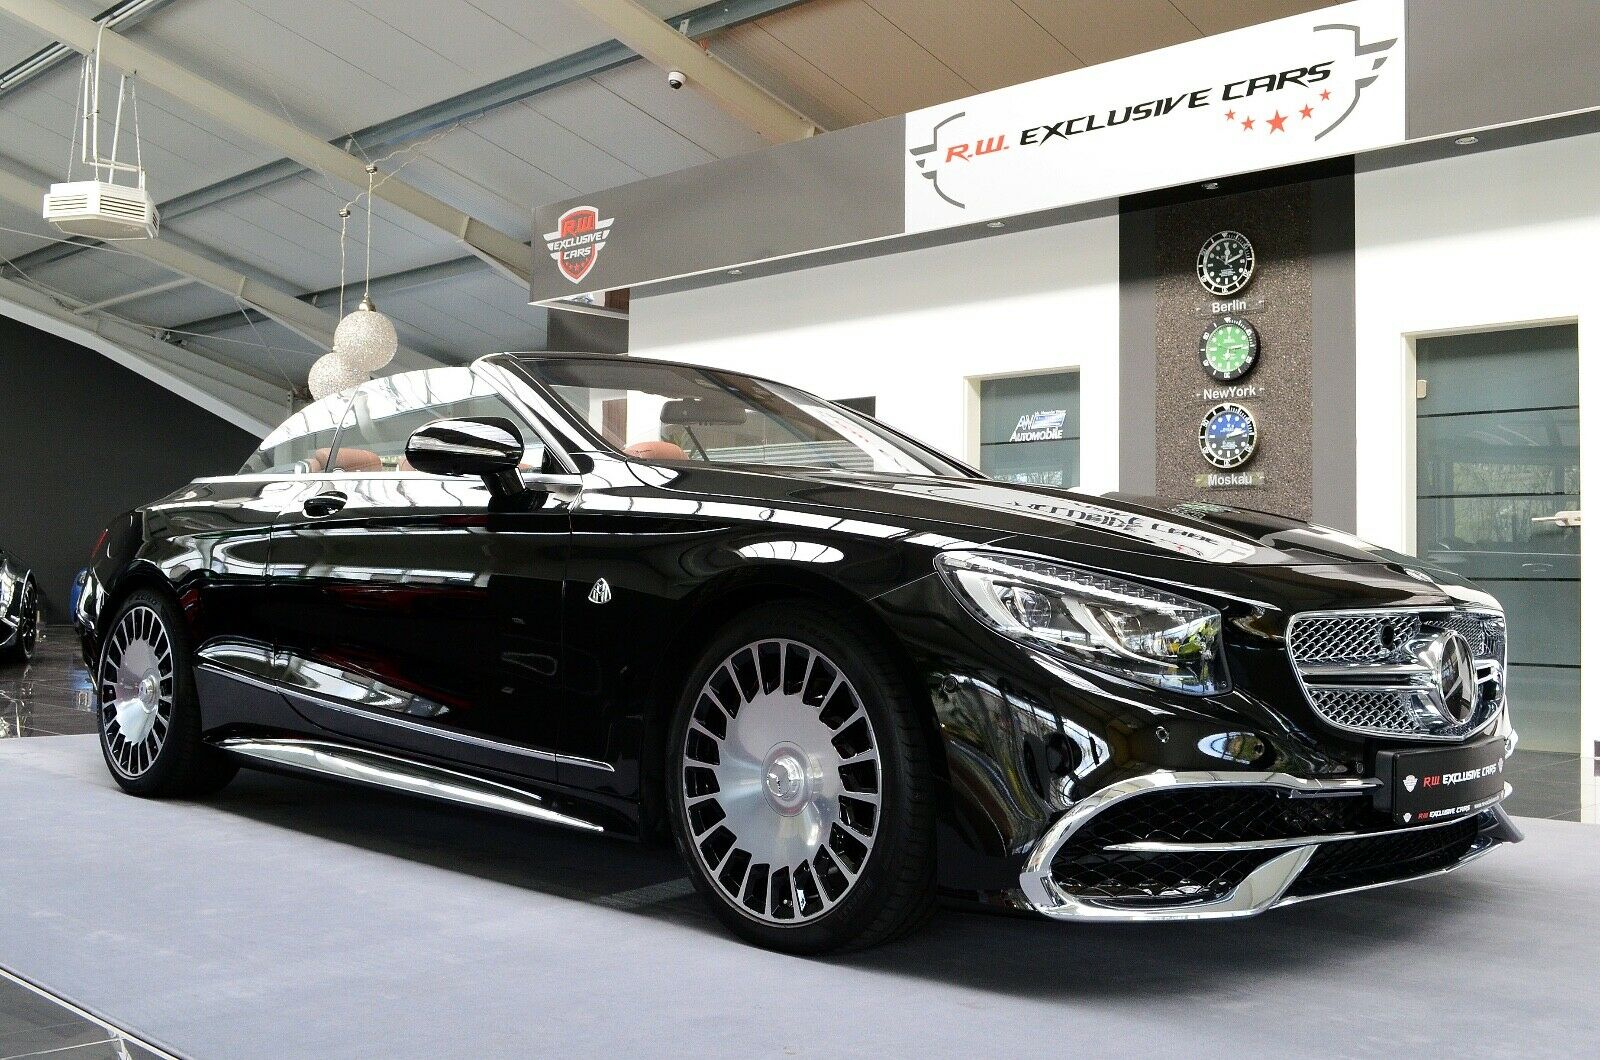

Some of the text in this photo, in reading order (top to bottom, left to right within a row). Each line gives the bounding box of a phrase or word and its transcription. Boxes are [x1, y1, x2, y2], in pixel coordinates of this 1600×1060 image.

[945, 60, 1335, 163] R.W. EXCLUSIVE CARS
[553, 231, 602, 251] EXCLUSIVE
[563, 246, 592, 260] CARS
[1212, 299, 1247, 313] Berlin
[1207, 472, 1252, 487] Moskau
[1442, 768, 1481, 786] EXCLUSIVE
[1482, 764, 1497, 776] CARS
